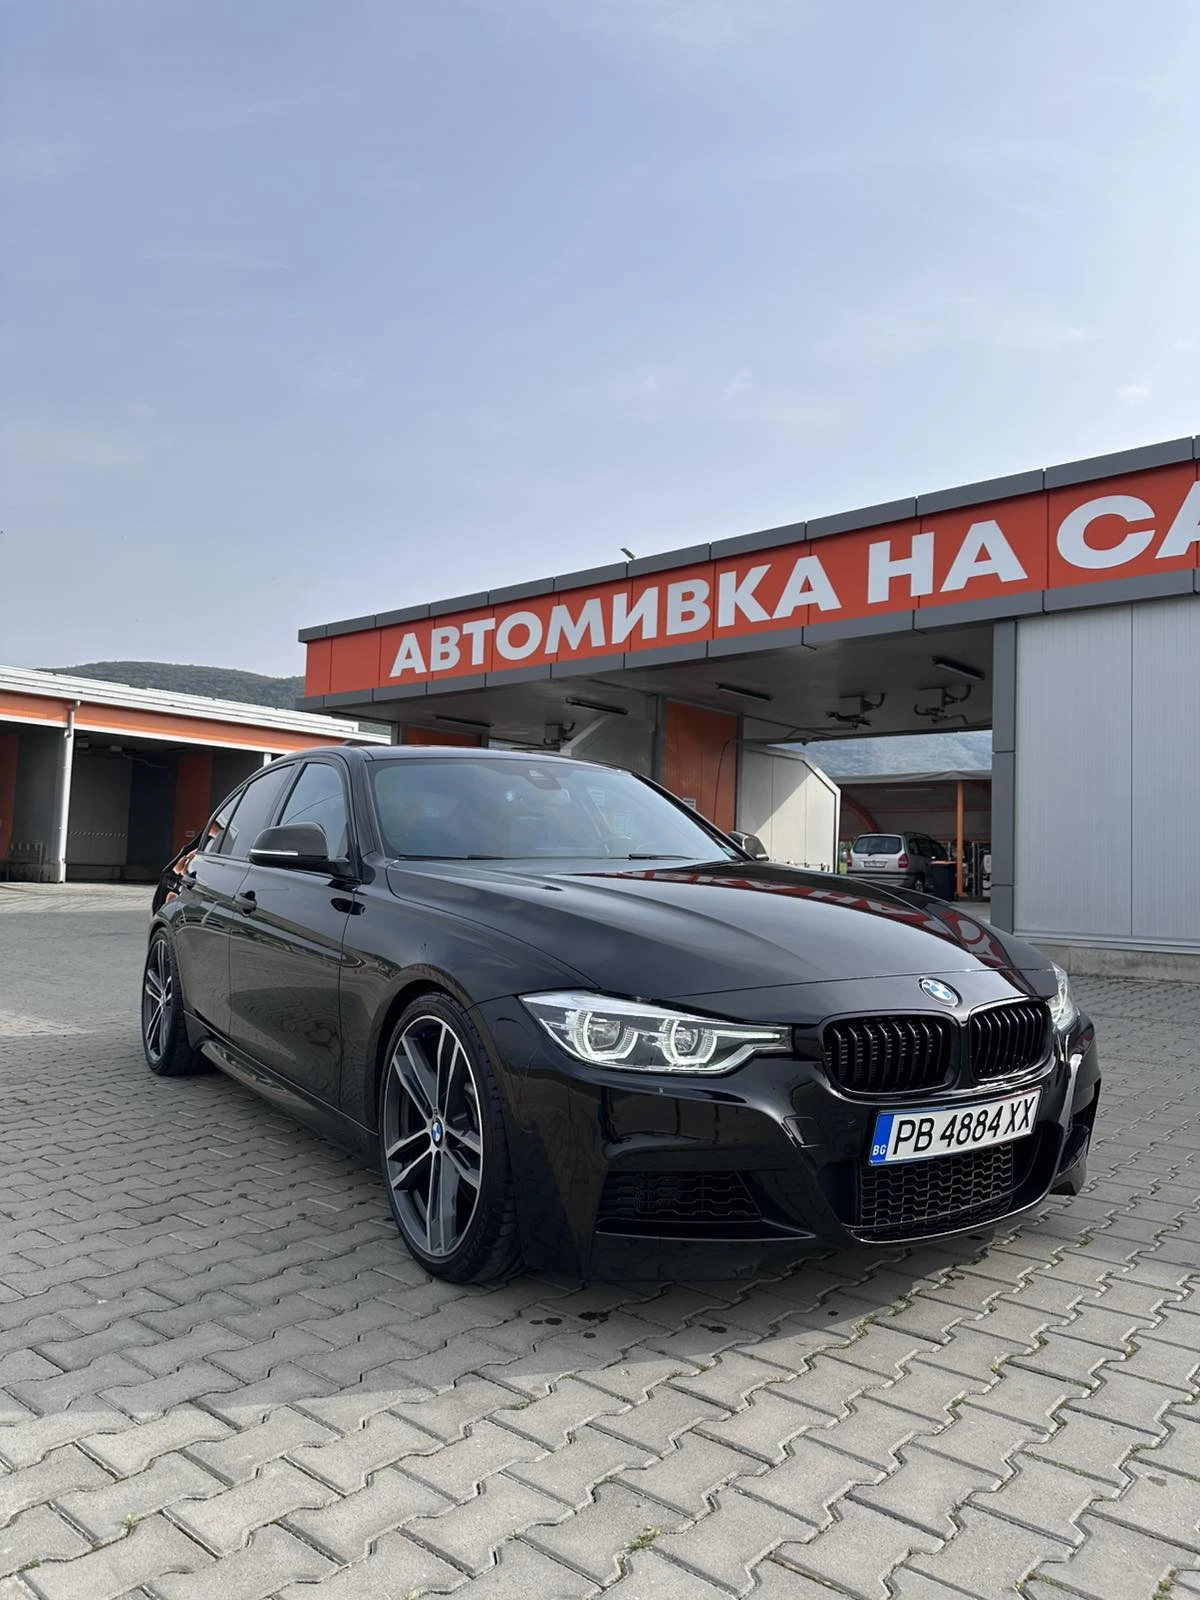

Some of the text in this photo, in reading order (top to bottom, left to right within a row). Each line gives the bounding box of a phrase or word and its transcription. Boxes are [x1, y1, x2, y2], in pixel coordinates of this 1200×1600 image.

[389, 554, 841, 678] АВТОМИВКА
[868, 519, 1028, 604] НА
[872, 1144, 887, 1156] BG
